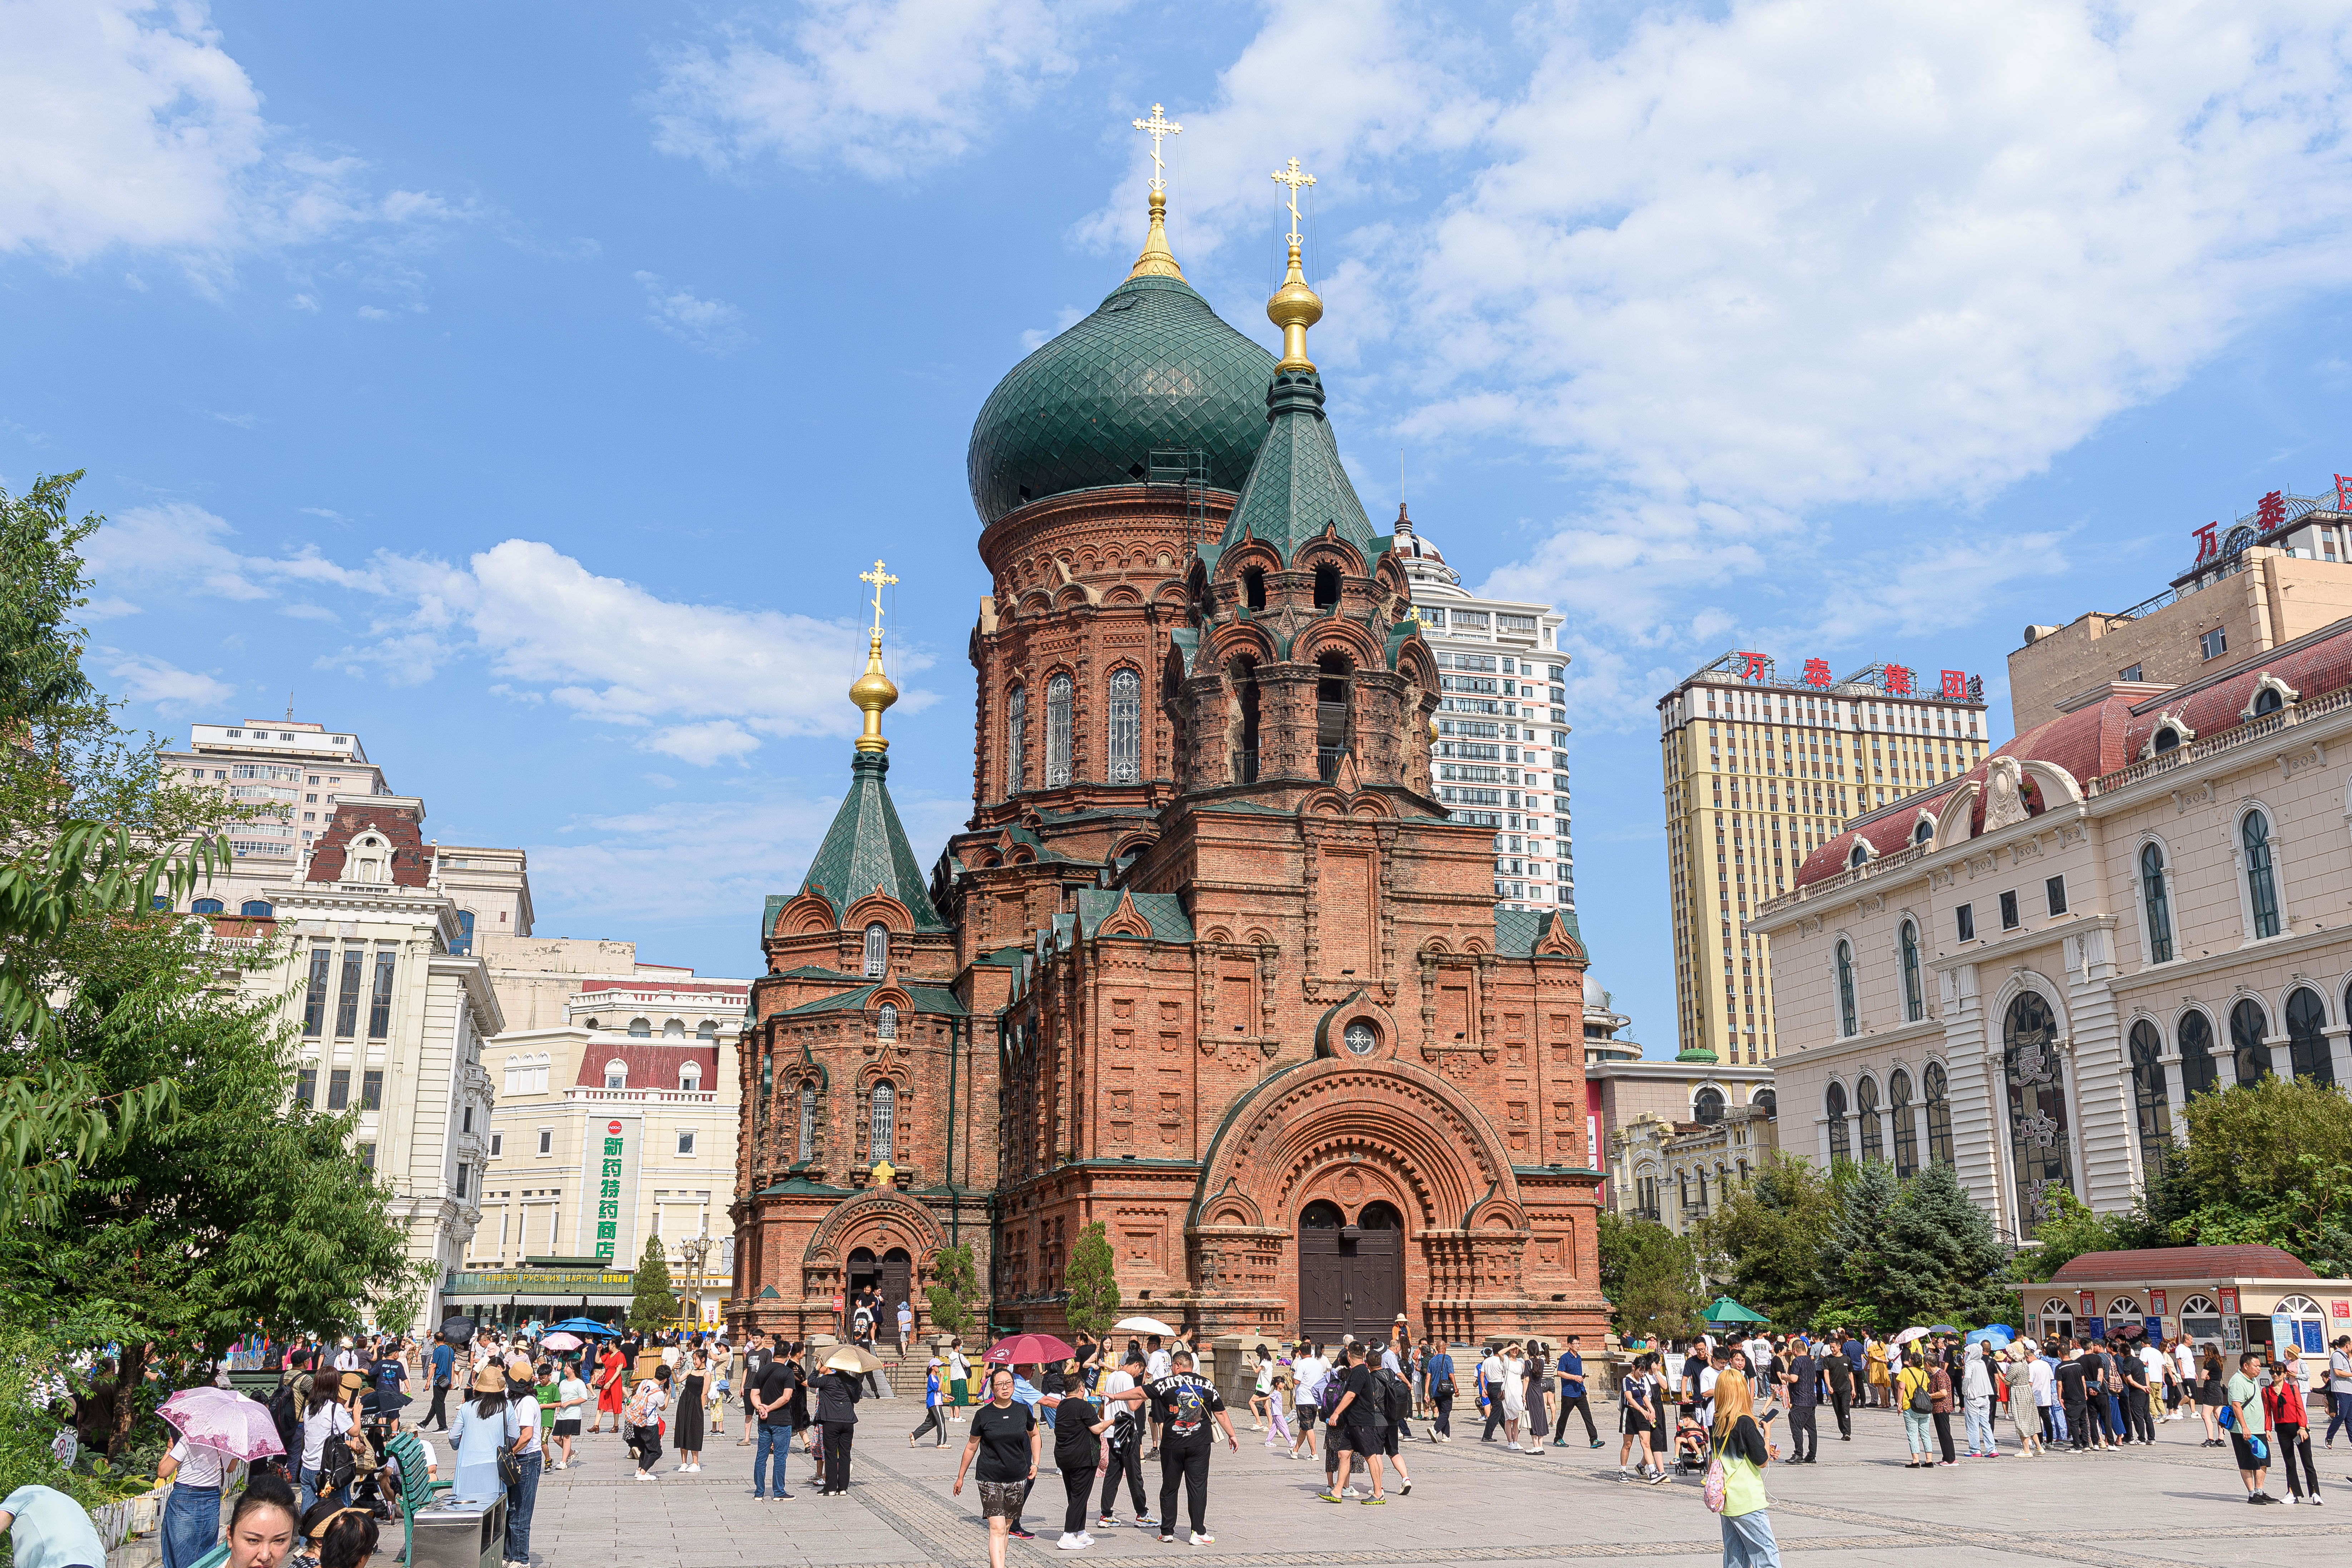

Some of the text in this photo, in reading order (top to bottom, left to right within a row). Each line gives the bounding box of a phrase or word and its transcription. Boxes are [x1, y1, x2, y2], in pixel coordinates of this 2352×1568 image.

[1739, 652, 1967, 699] 万泰集团
[596, 1137, 623, 1258] 新药特药商店
[602, 1275, 628, 1283] 俄罗斯画廊
